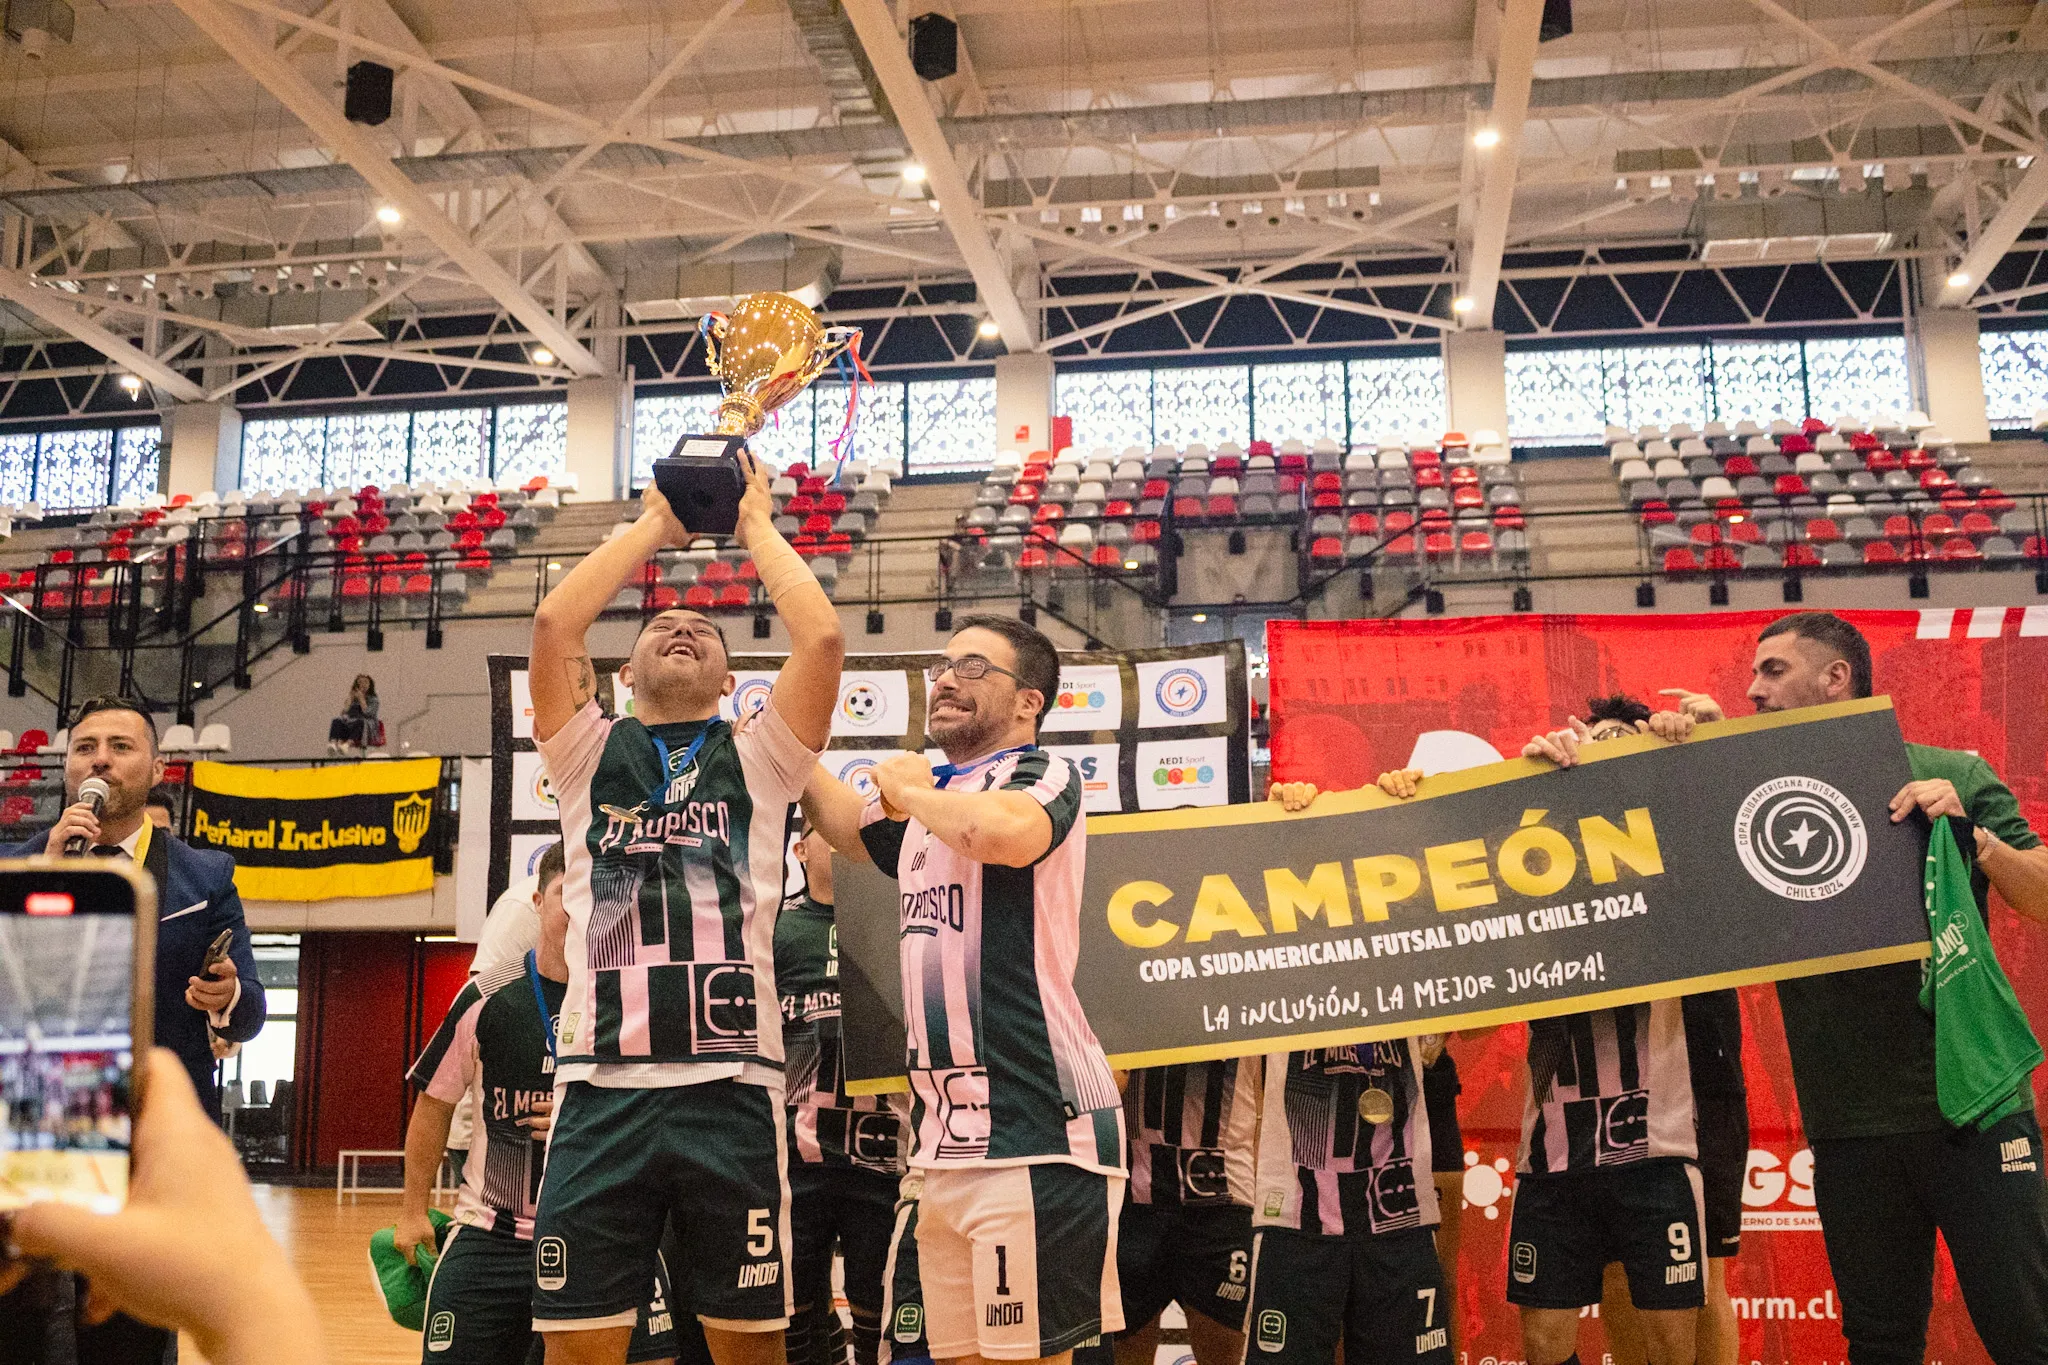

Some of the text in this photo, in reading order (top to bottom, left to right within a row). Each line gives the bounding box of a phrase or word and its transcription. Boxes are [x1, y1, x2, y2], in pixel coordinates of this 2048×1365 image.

[1159, 757, 1182, 765] AEDI
[193, 808, 387, 851] Peñarol Inclusivo
[1739, 778, 1861, 846] COPA SUDAMERICANA FUTSAL DOWN
[1107, 806, 1665, 949] CAMPEÓN
[1785, 879, 1845, 898] CHILE 2024
[1139, 891, 1649, 984] COPA SUDAMERICANA FUTSAL DOWN CHILE 2024
[1203, 1004, 1230, 1032] LA
[1376, 984, 1404, 1013] LA
[1413, 973, 1497, 1009] MEJOR
[1506, 951, 1606, 994] JUGADA!
[494, 1087, 509, 1120] EL
[747, 1208, 774, 1257] 5
[1667, 1222, 1692, 1262] 9
[1742, 1217, 1773, 1226] ERNO
[1776, 1217, 1790, 1226] DE
[995, 1244, 1011, 1297] 1
[1229, 1250, 1248, 1284] 6
[1417, 1287, 1436, 1328] 7
